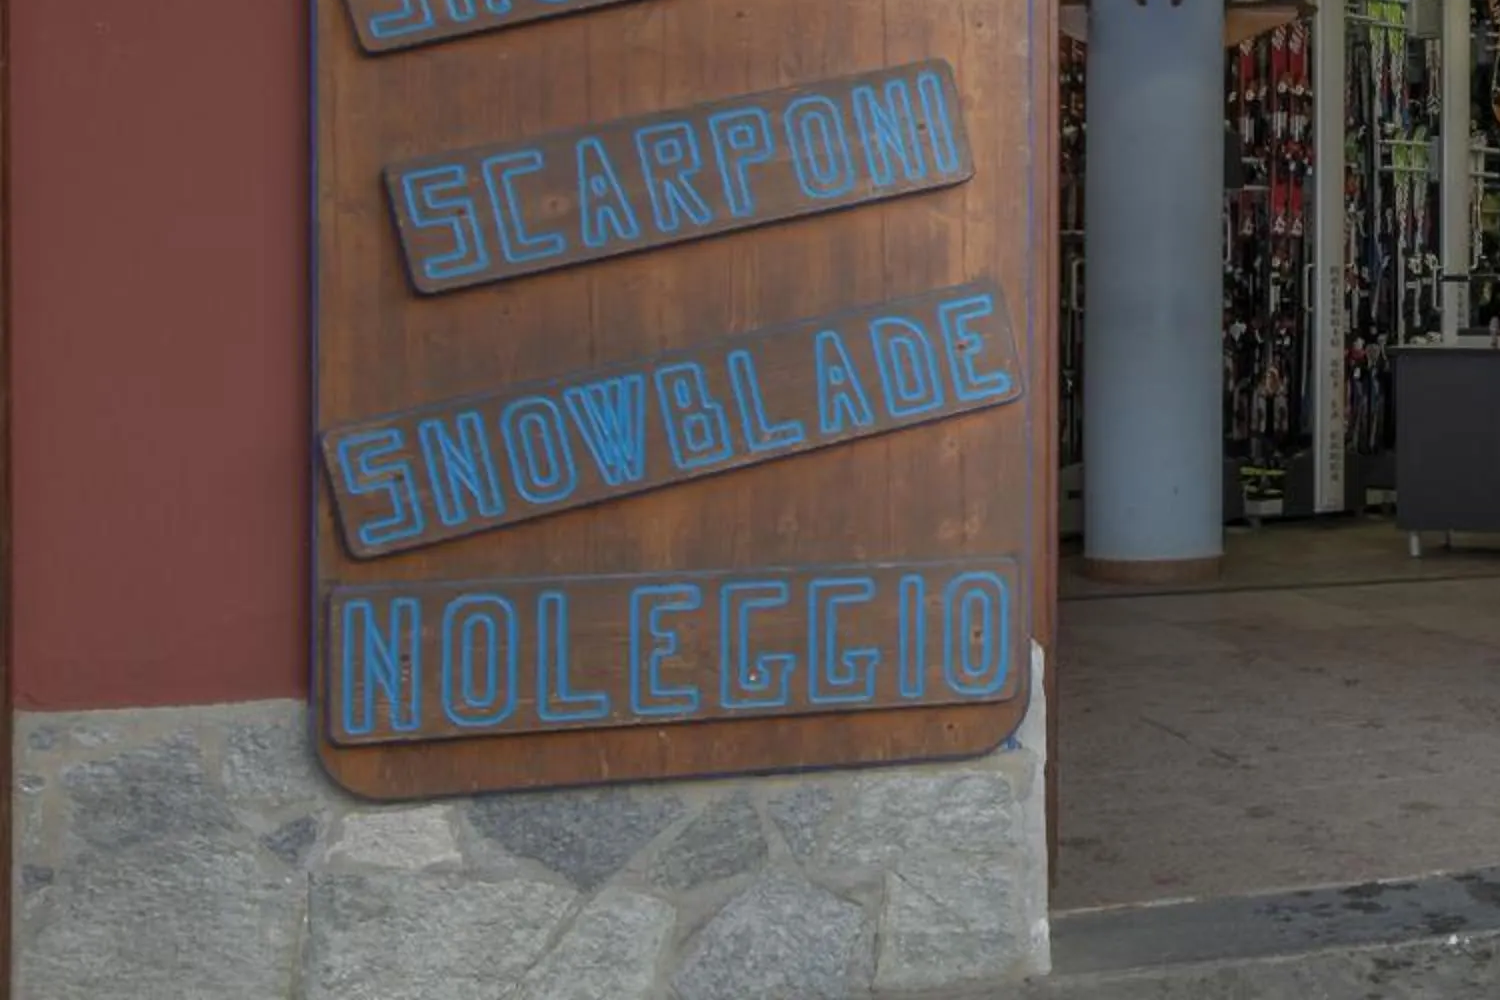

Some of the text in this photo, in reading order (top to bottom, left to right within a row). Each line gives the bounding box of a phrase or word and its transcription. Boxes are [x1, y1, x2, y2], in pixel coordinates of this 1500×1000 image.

[402, 70, 960, 279] SCARPONI
[337, 293, 1011, 545] SNOWBLADE
[341, 571, 1009, 734] NOLEGGIO
